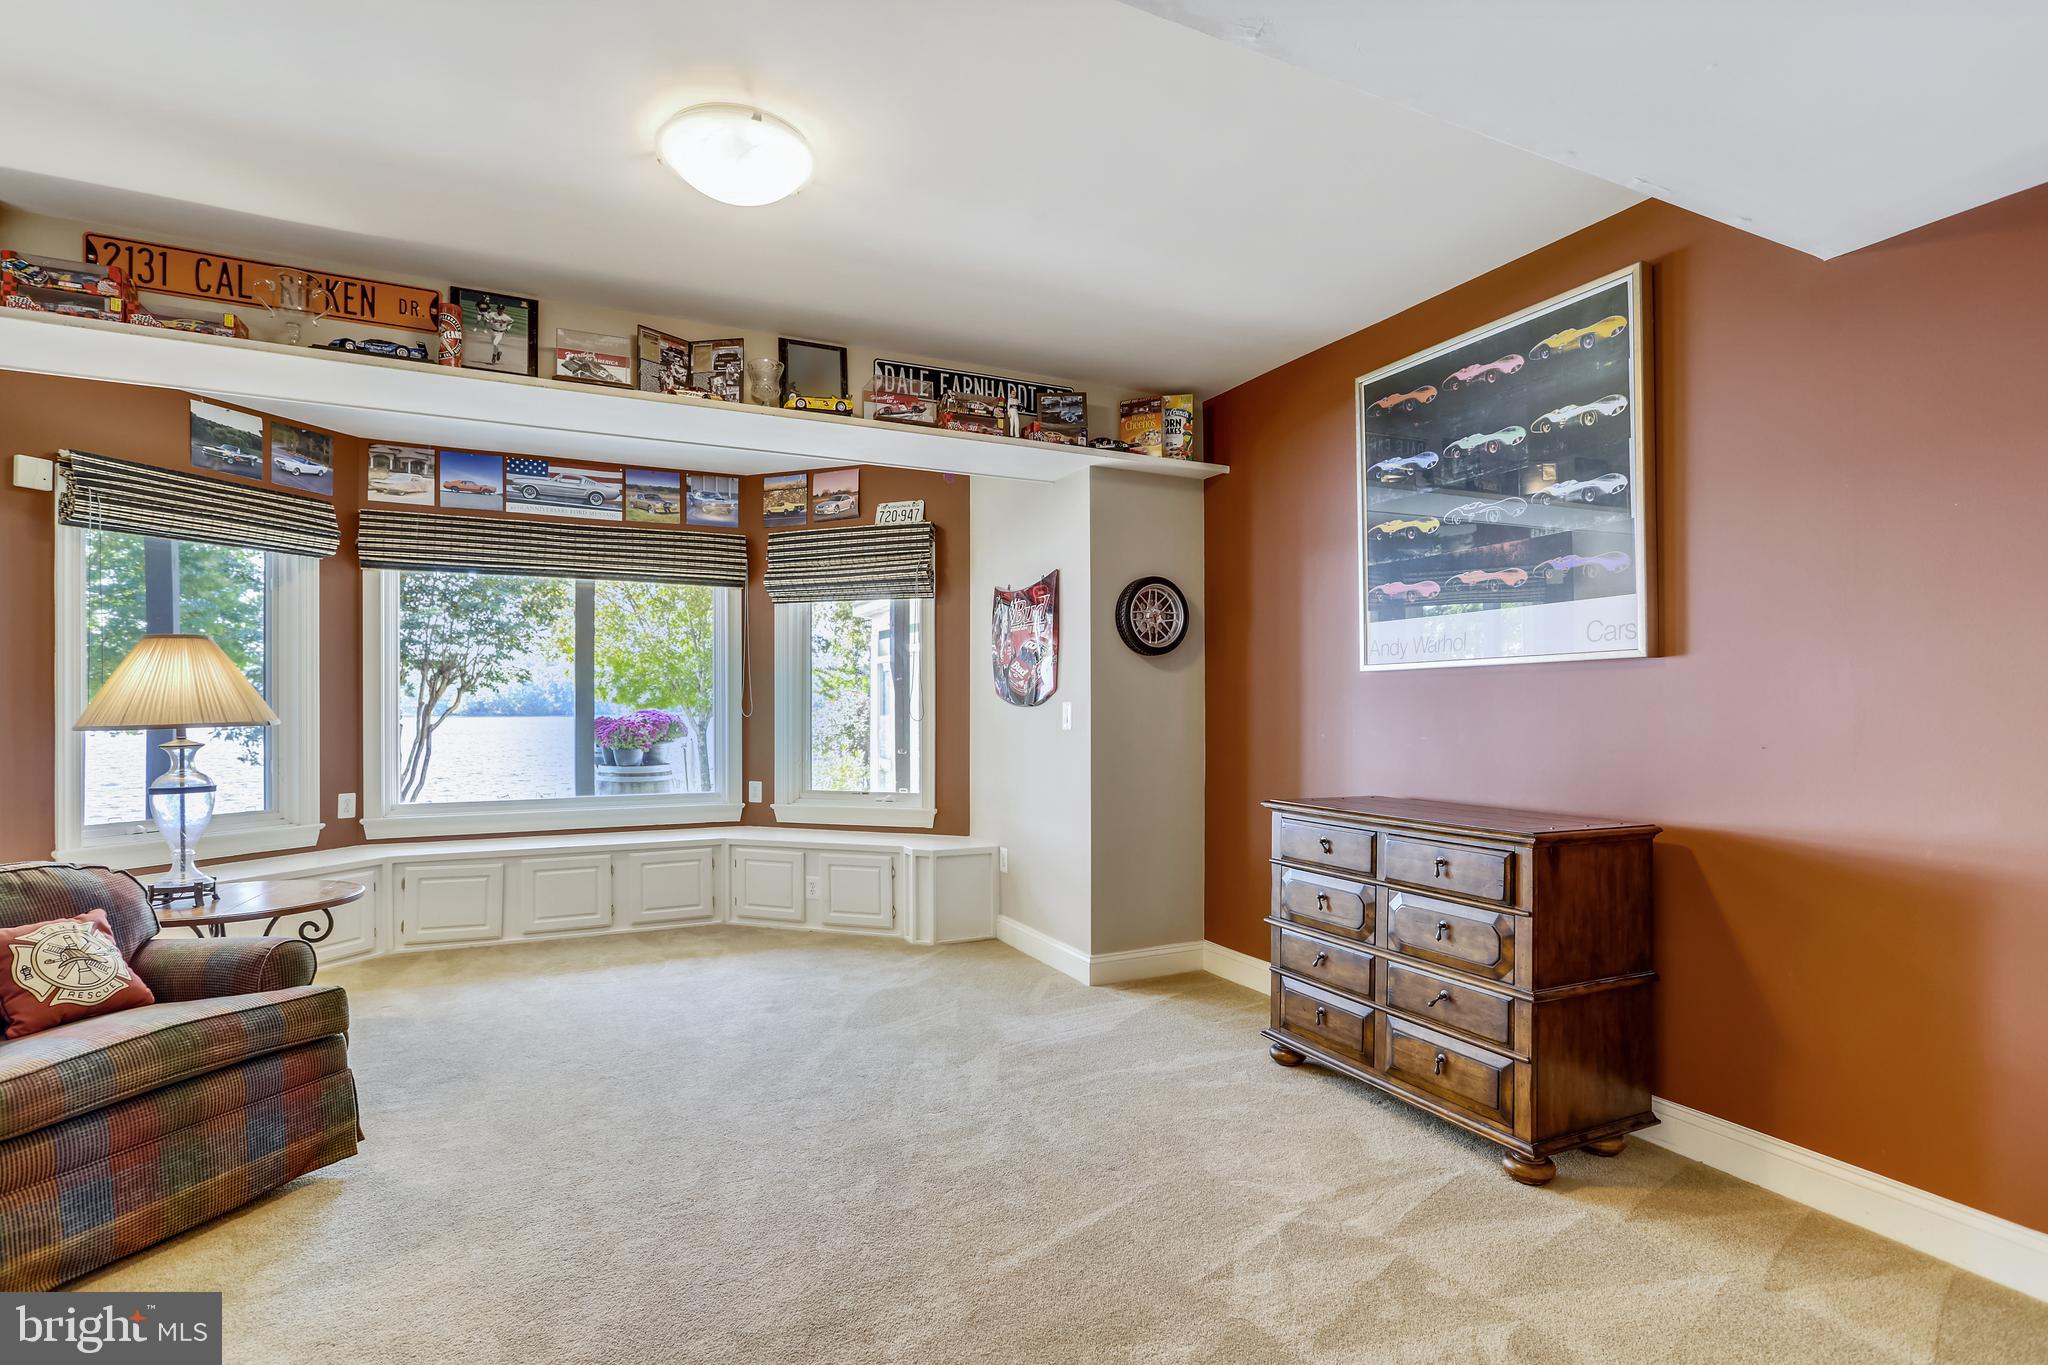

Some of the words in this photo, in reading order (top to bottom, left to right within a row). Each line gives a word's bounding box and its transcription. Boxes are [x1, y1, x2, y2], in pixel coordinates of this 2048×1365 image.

[102, 241, 168, 287] 2131
[194, 257, 253, 300] CAL
[279, 271, 376, 319] RIPKEN
[399, 298, 425, 319] DR.
[594, 358, 619, 366] AMERICA
[885, 365, 930, 398] DALE
[1125, 419, 1157, 431] Cheerios
[1165, 418, 1182, 428] ORN
[1165, 427, 1182, 435] AKES
[526, 506, 568, 514] ANNIVERSARY
[1012, 594, 1051, 626] Bud
[1585, 620, 1638, 644] Cars
[1369, 632, 1408, 659] Andy
[1412, 632, 1467, 655] Warhol
[1010, 661, 1029, 677] Bud
[66, 982, 117, 1000] RESCUE
